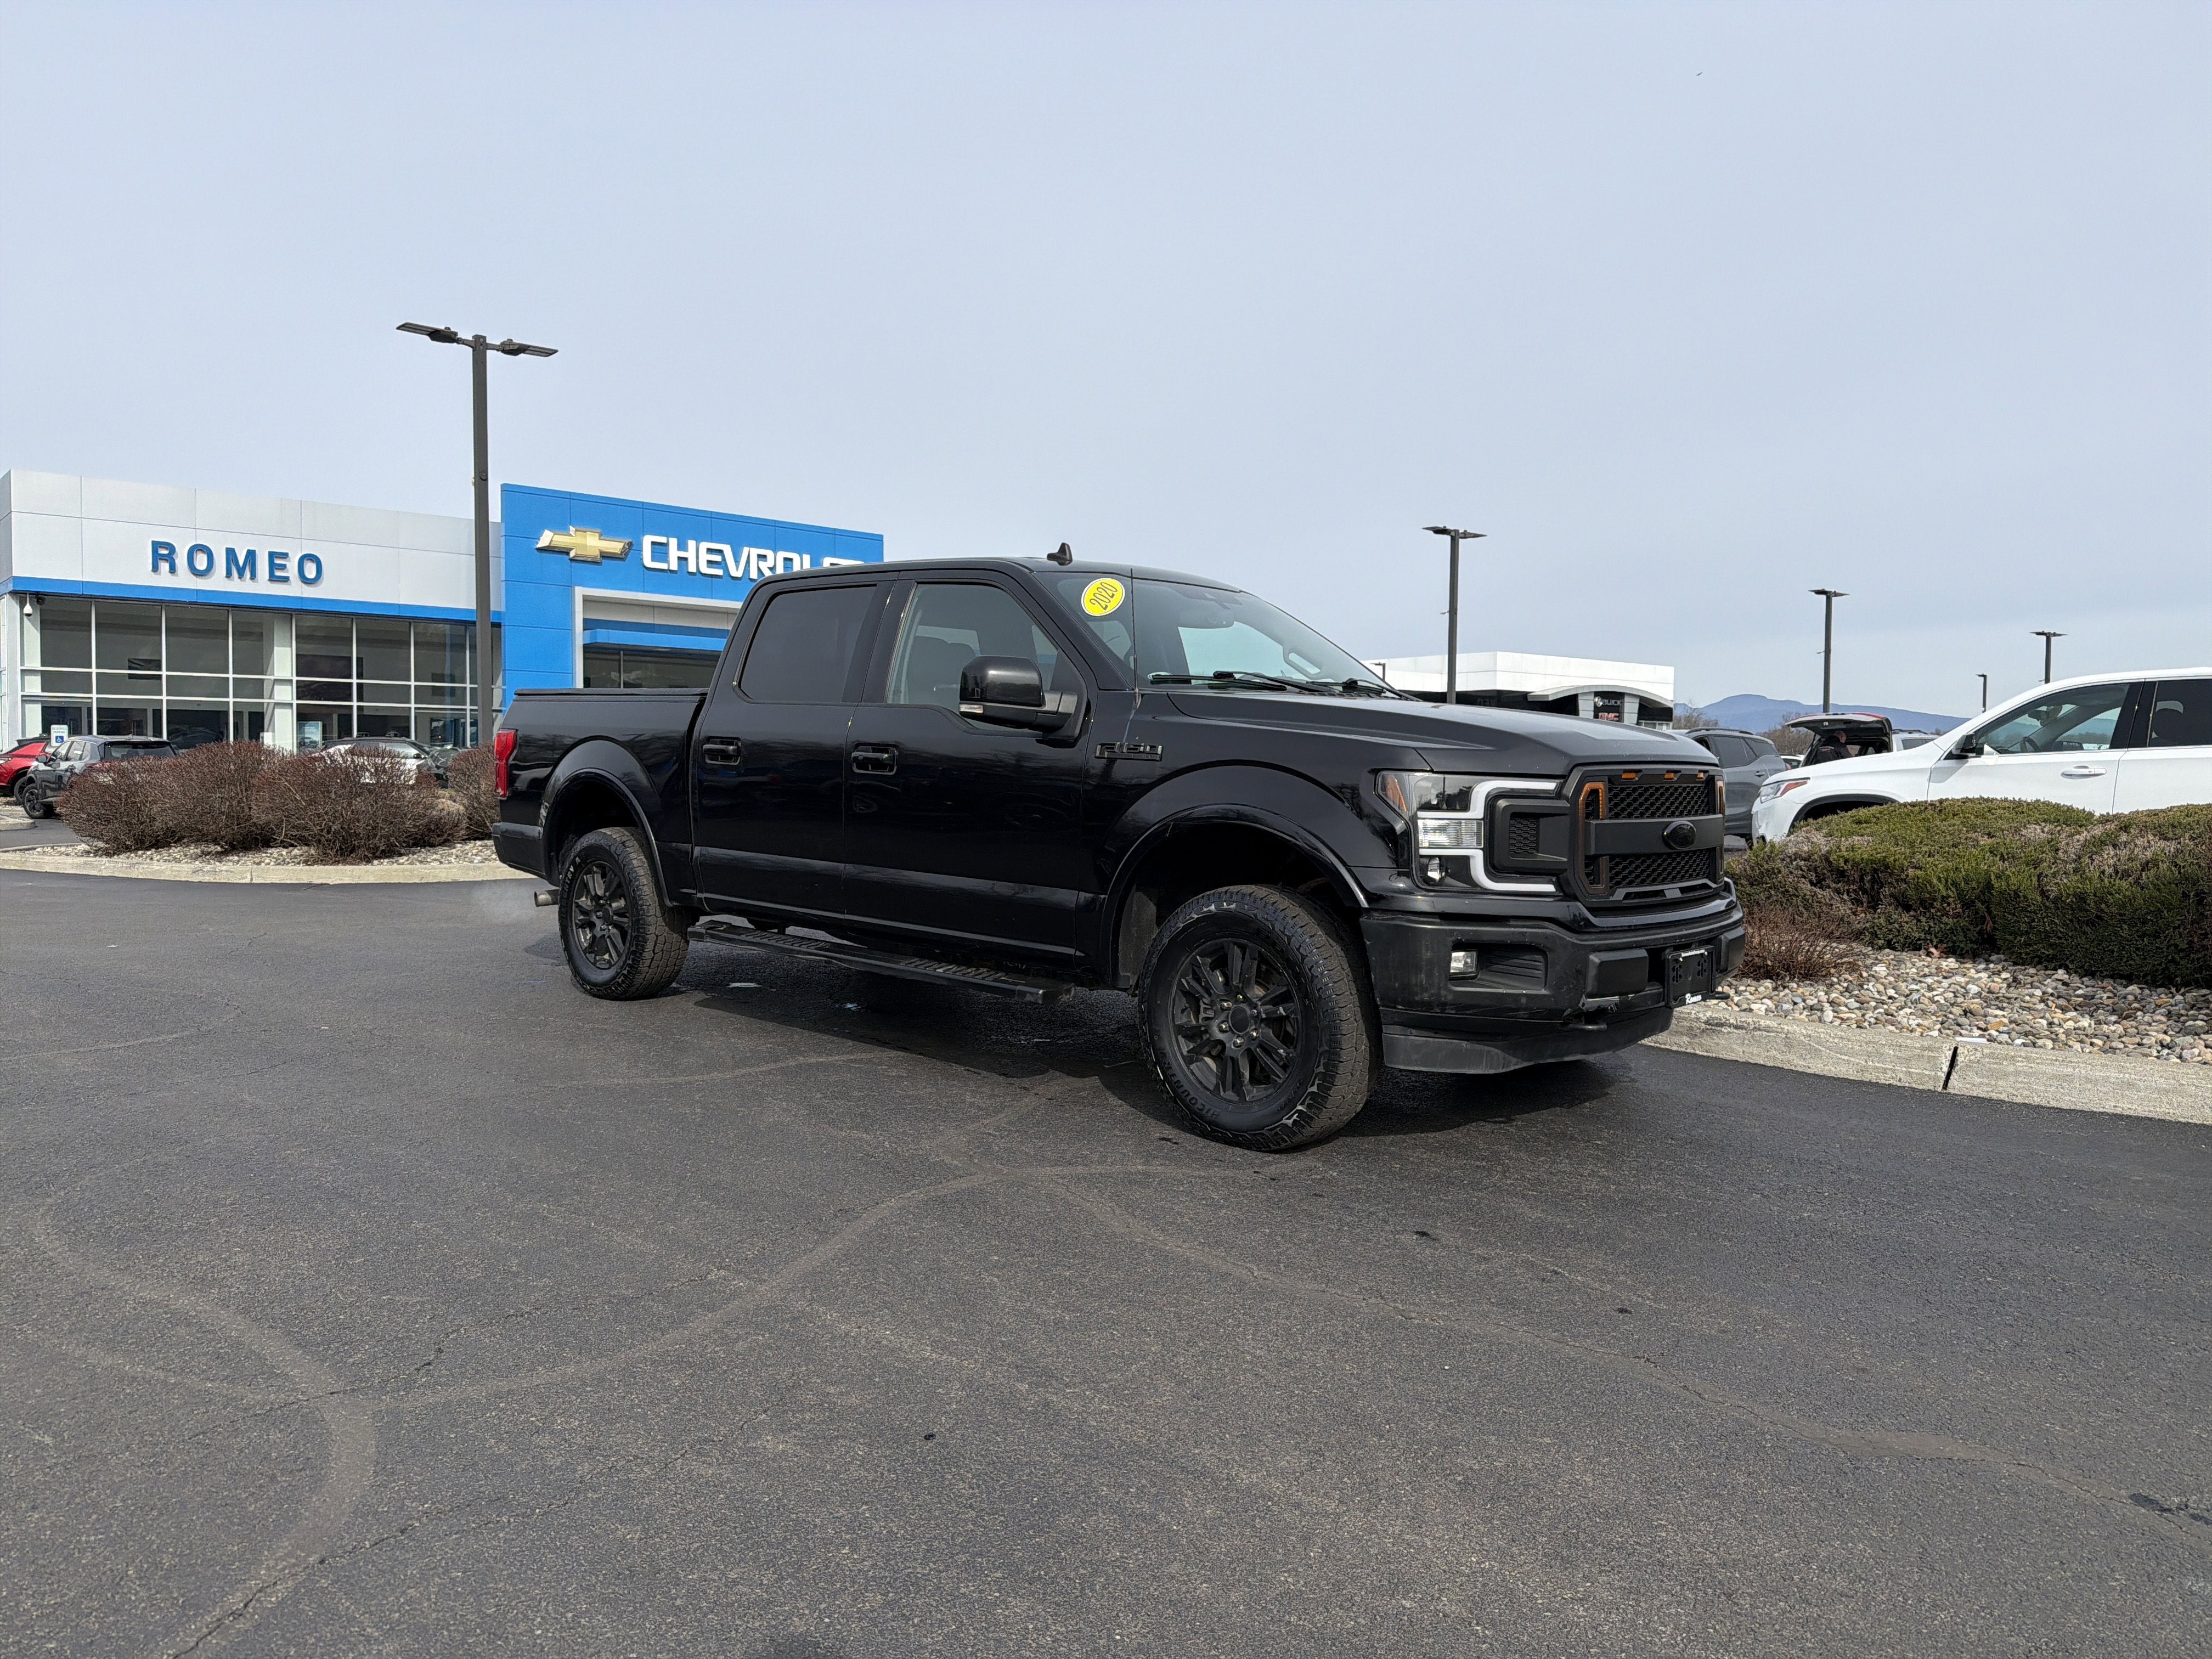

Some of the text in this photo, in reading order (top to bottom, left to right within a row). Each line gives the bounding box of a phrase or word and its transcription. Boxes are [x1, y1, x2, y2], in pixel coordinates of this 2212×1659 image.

[151, 540, 323, 584] ROMEO
[642, 534, 864, 580] CHEVRO
[1089, 582, 1118, 611] 2020
[1598, 712, 1619, 721] GMC
[1685, 993, 1702, 1005] Romeo
